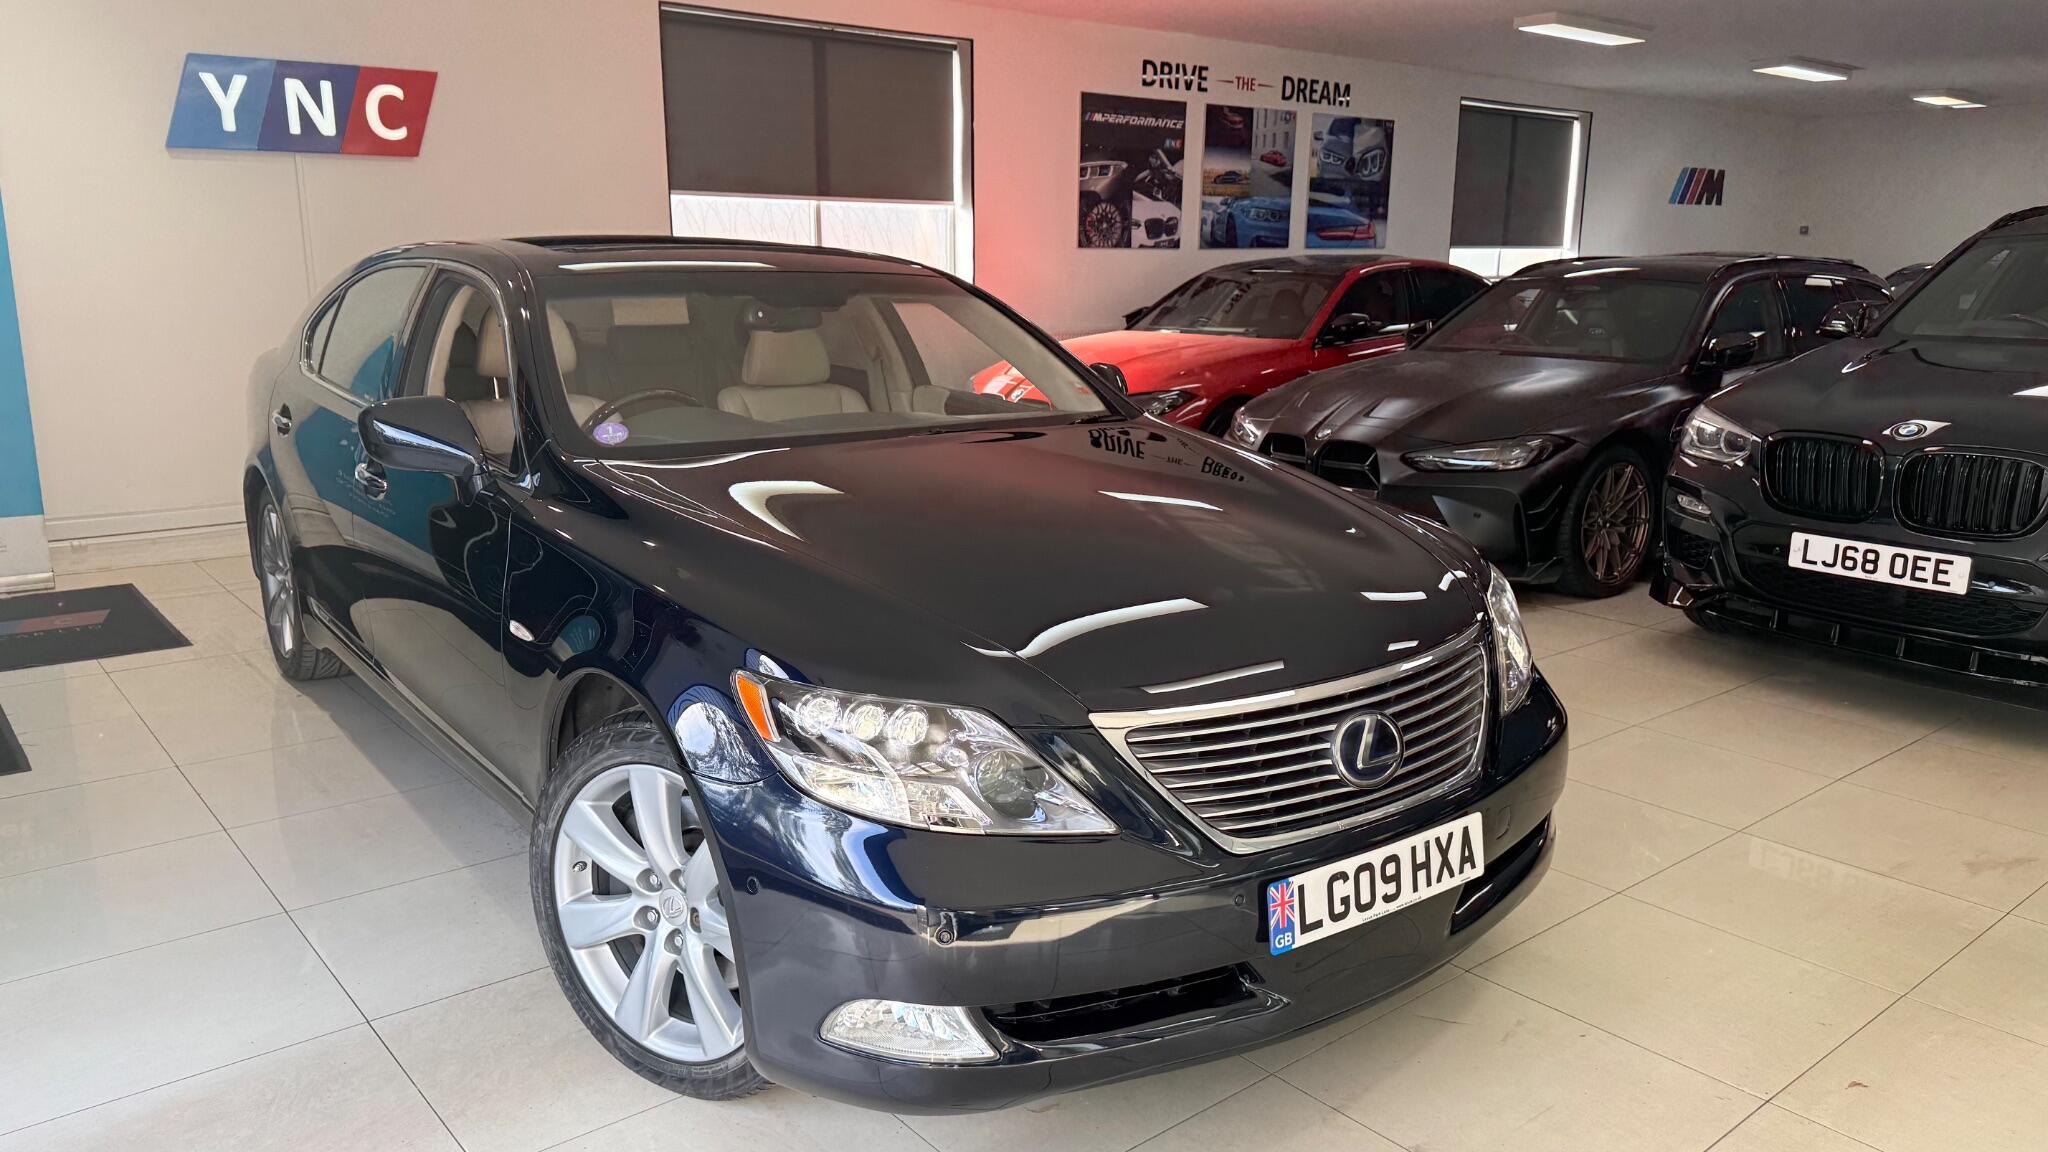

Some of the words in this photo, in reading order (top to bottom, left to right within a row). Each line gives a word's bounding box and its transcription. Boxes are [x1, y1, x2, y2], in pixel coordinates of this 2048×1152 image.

[1141, 59, 1209, 93] DRIVE
[1234, 76, 1257, 92] THE
[1281, 75, 1351, 108] DREAM
[1801, 539, 1880, 575] LJ68
[1888, 552, 1955, 587] OEE
[1297, 853, 1402, 936] LG09
[1410, 825, 1477, 894] HXA
[1274, 932, 1293, 949] GB
